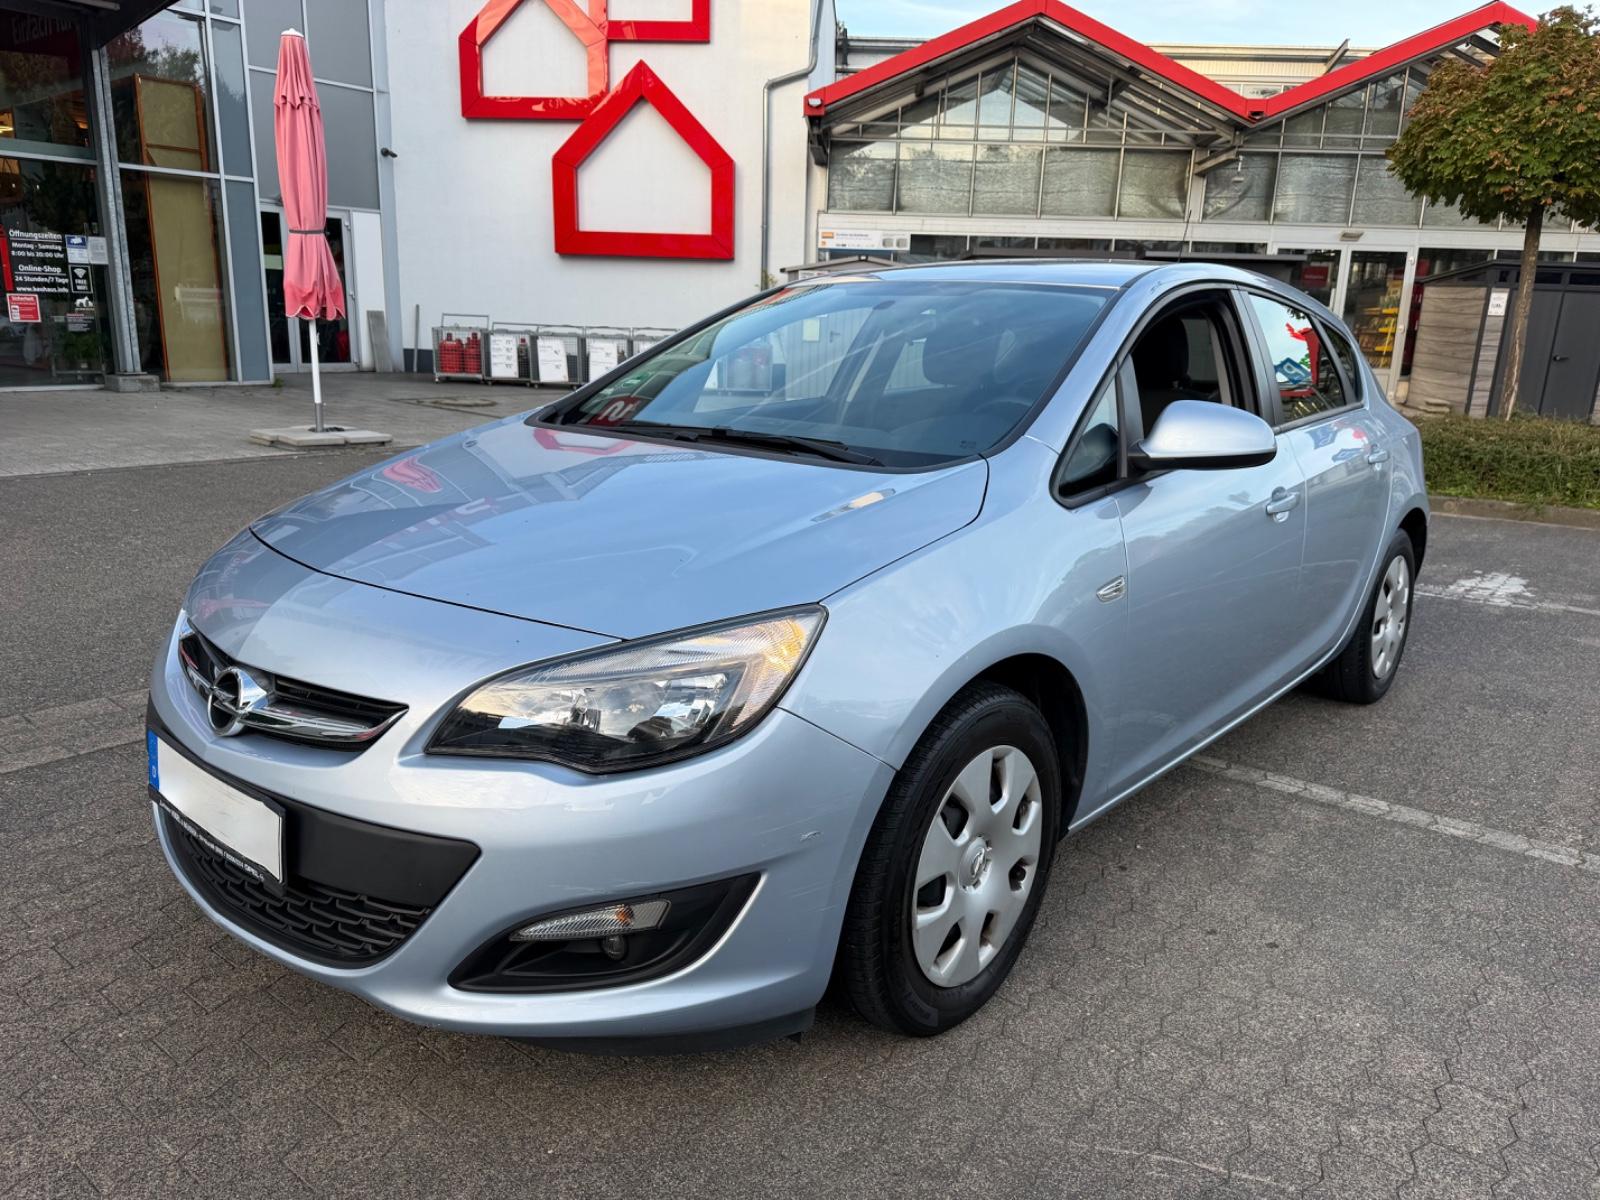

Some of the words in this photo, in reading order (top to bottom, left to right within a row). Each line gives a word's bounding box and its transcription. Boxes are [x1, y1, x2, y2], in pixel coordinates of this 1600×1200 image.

[8, 229, 62, 240] Öffnungszeiten
[11, 242, 34, 250] Montag
[38, 243, 62, 251] Samstag
[18, 264, 62, 274] Online-Shop
